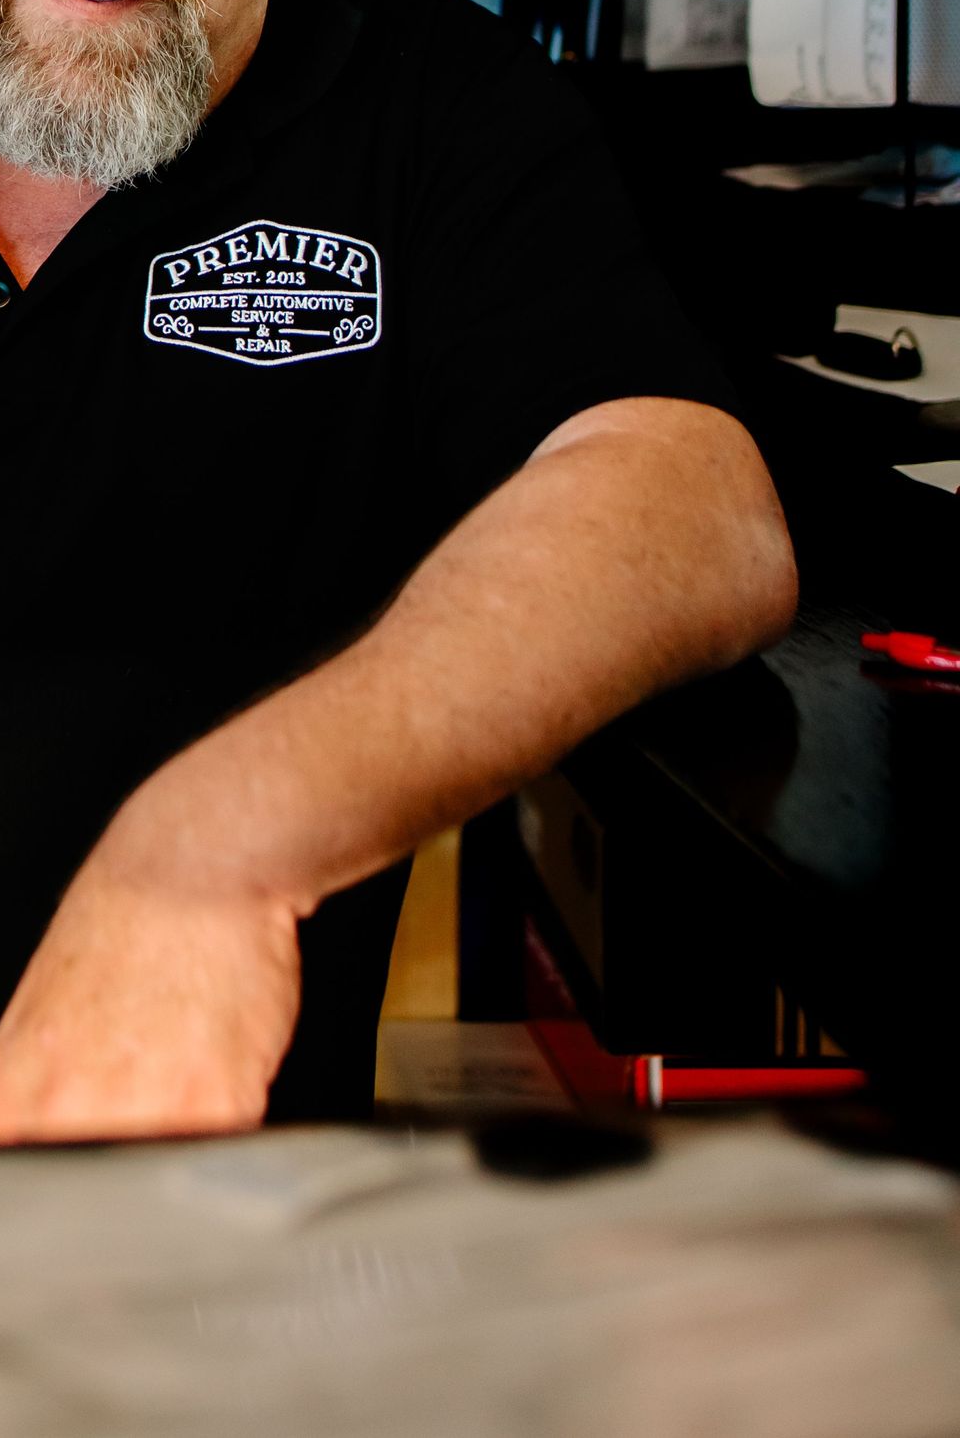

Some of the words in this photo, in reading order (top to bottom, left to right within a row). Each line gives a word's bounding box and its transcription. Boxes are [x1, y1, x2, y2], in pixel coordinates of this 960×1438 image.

[164, 231, 369, 287] PREMIER
[222, 272, 260, 285] EST.
[266, 271, 306, 285] 2013
[169, 295, 248, 311] COMPLETE
[253, 295, 354, 312] AUTOMOTIVE
[231, 310, 295, 324] SERVICE
[256, 324, 271, 337] &
[235, 338, 293, 353] REPAIR
